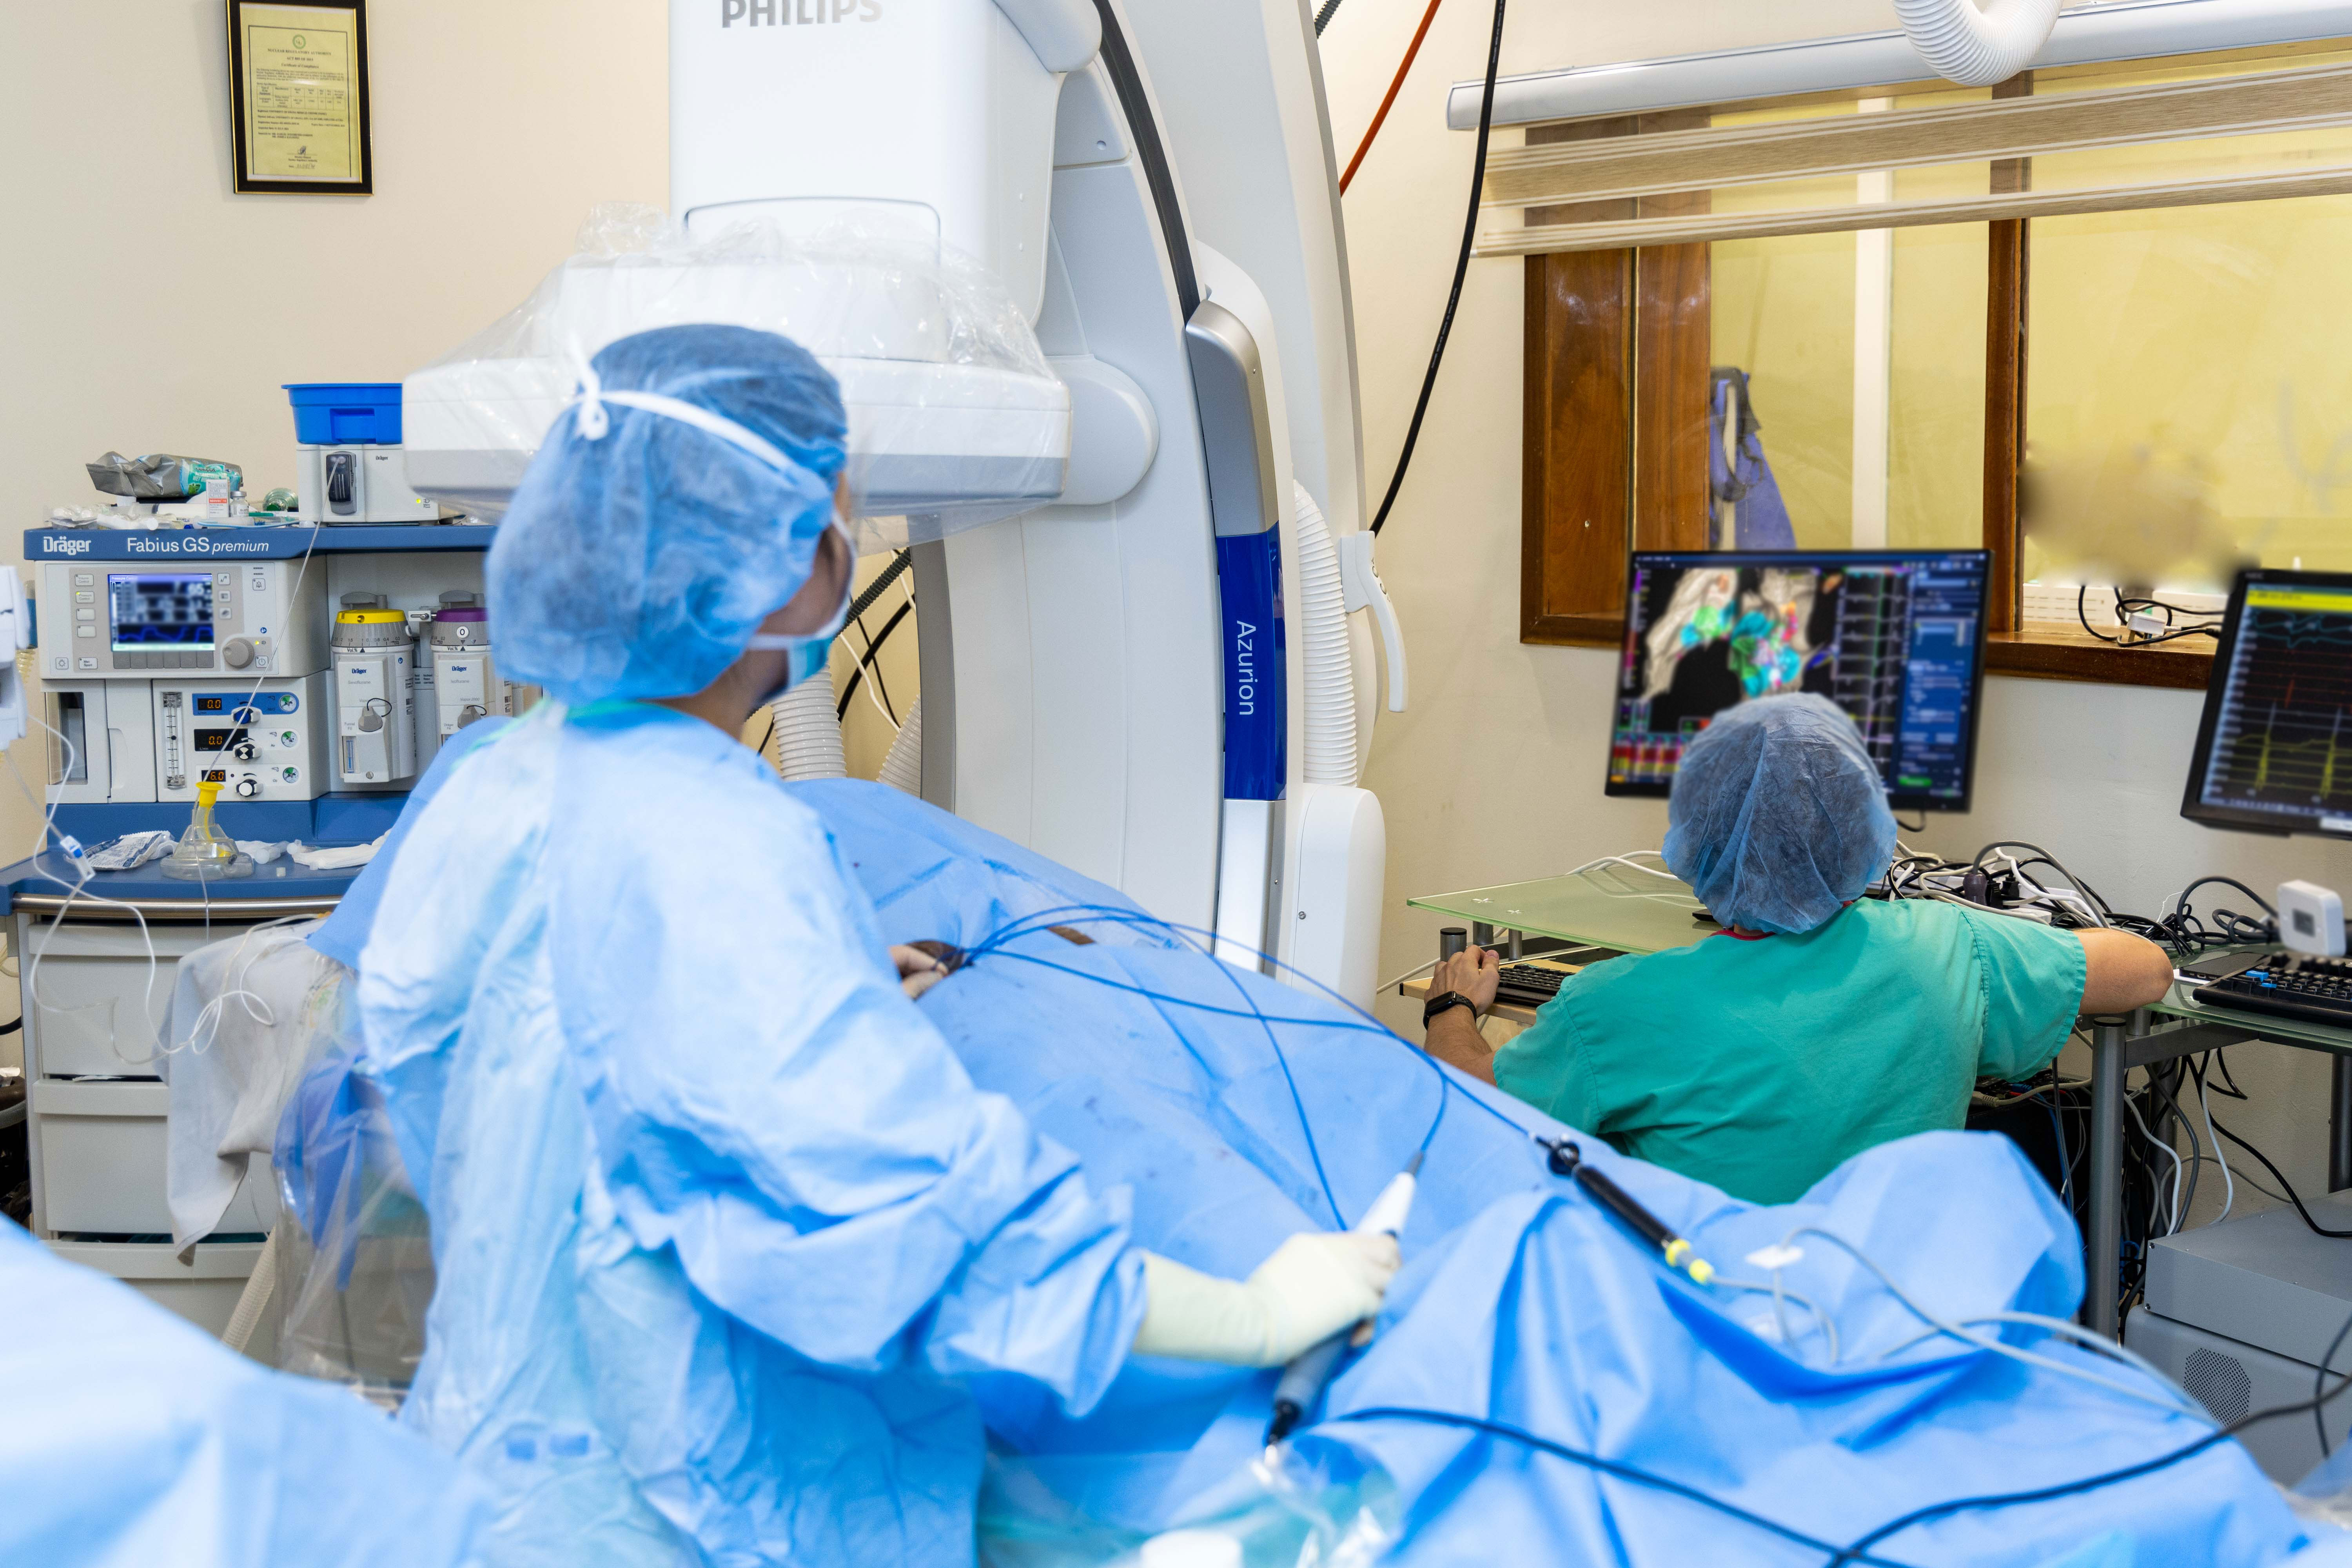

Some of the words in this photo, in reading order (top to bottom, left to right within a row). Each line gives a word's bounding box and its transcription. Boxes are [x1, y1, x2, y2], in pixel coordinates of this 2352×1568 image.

[722, 0, 883, 28] PHILIPS
[44, 536, 91, 555] Dräger
[127, 537, 179, 552] Fabius
[183, 537, 210, 552] GS
[212, 540, 269, 555] premium
[1237, 621, 1258, 715] Azurion
[207, 700, 221, 708] 0.0
[209, 736, 222, 745] 0.0
[210, 772, 224, 780] 6.0
